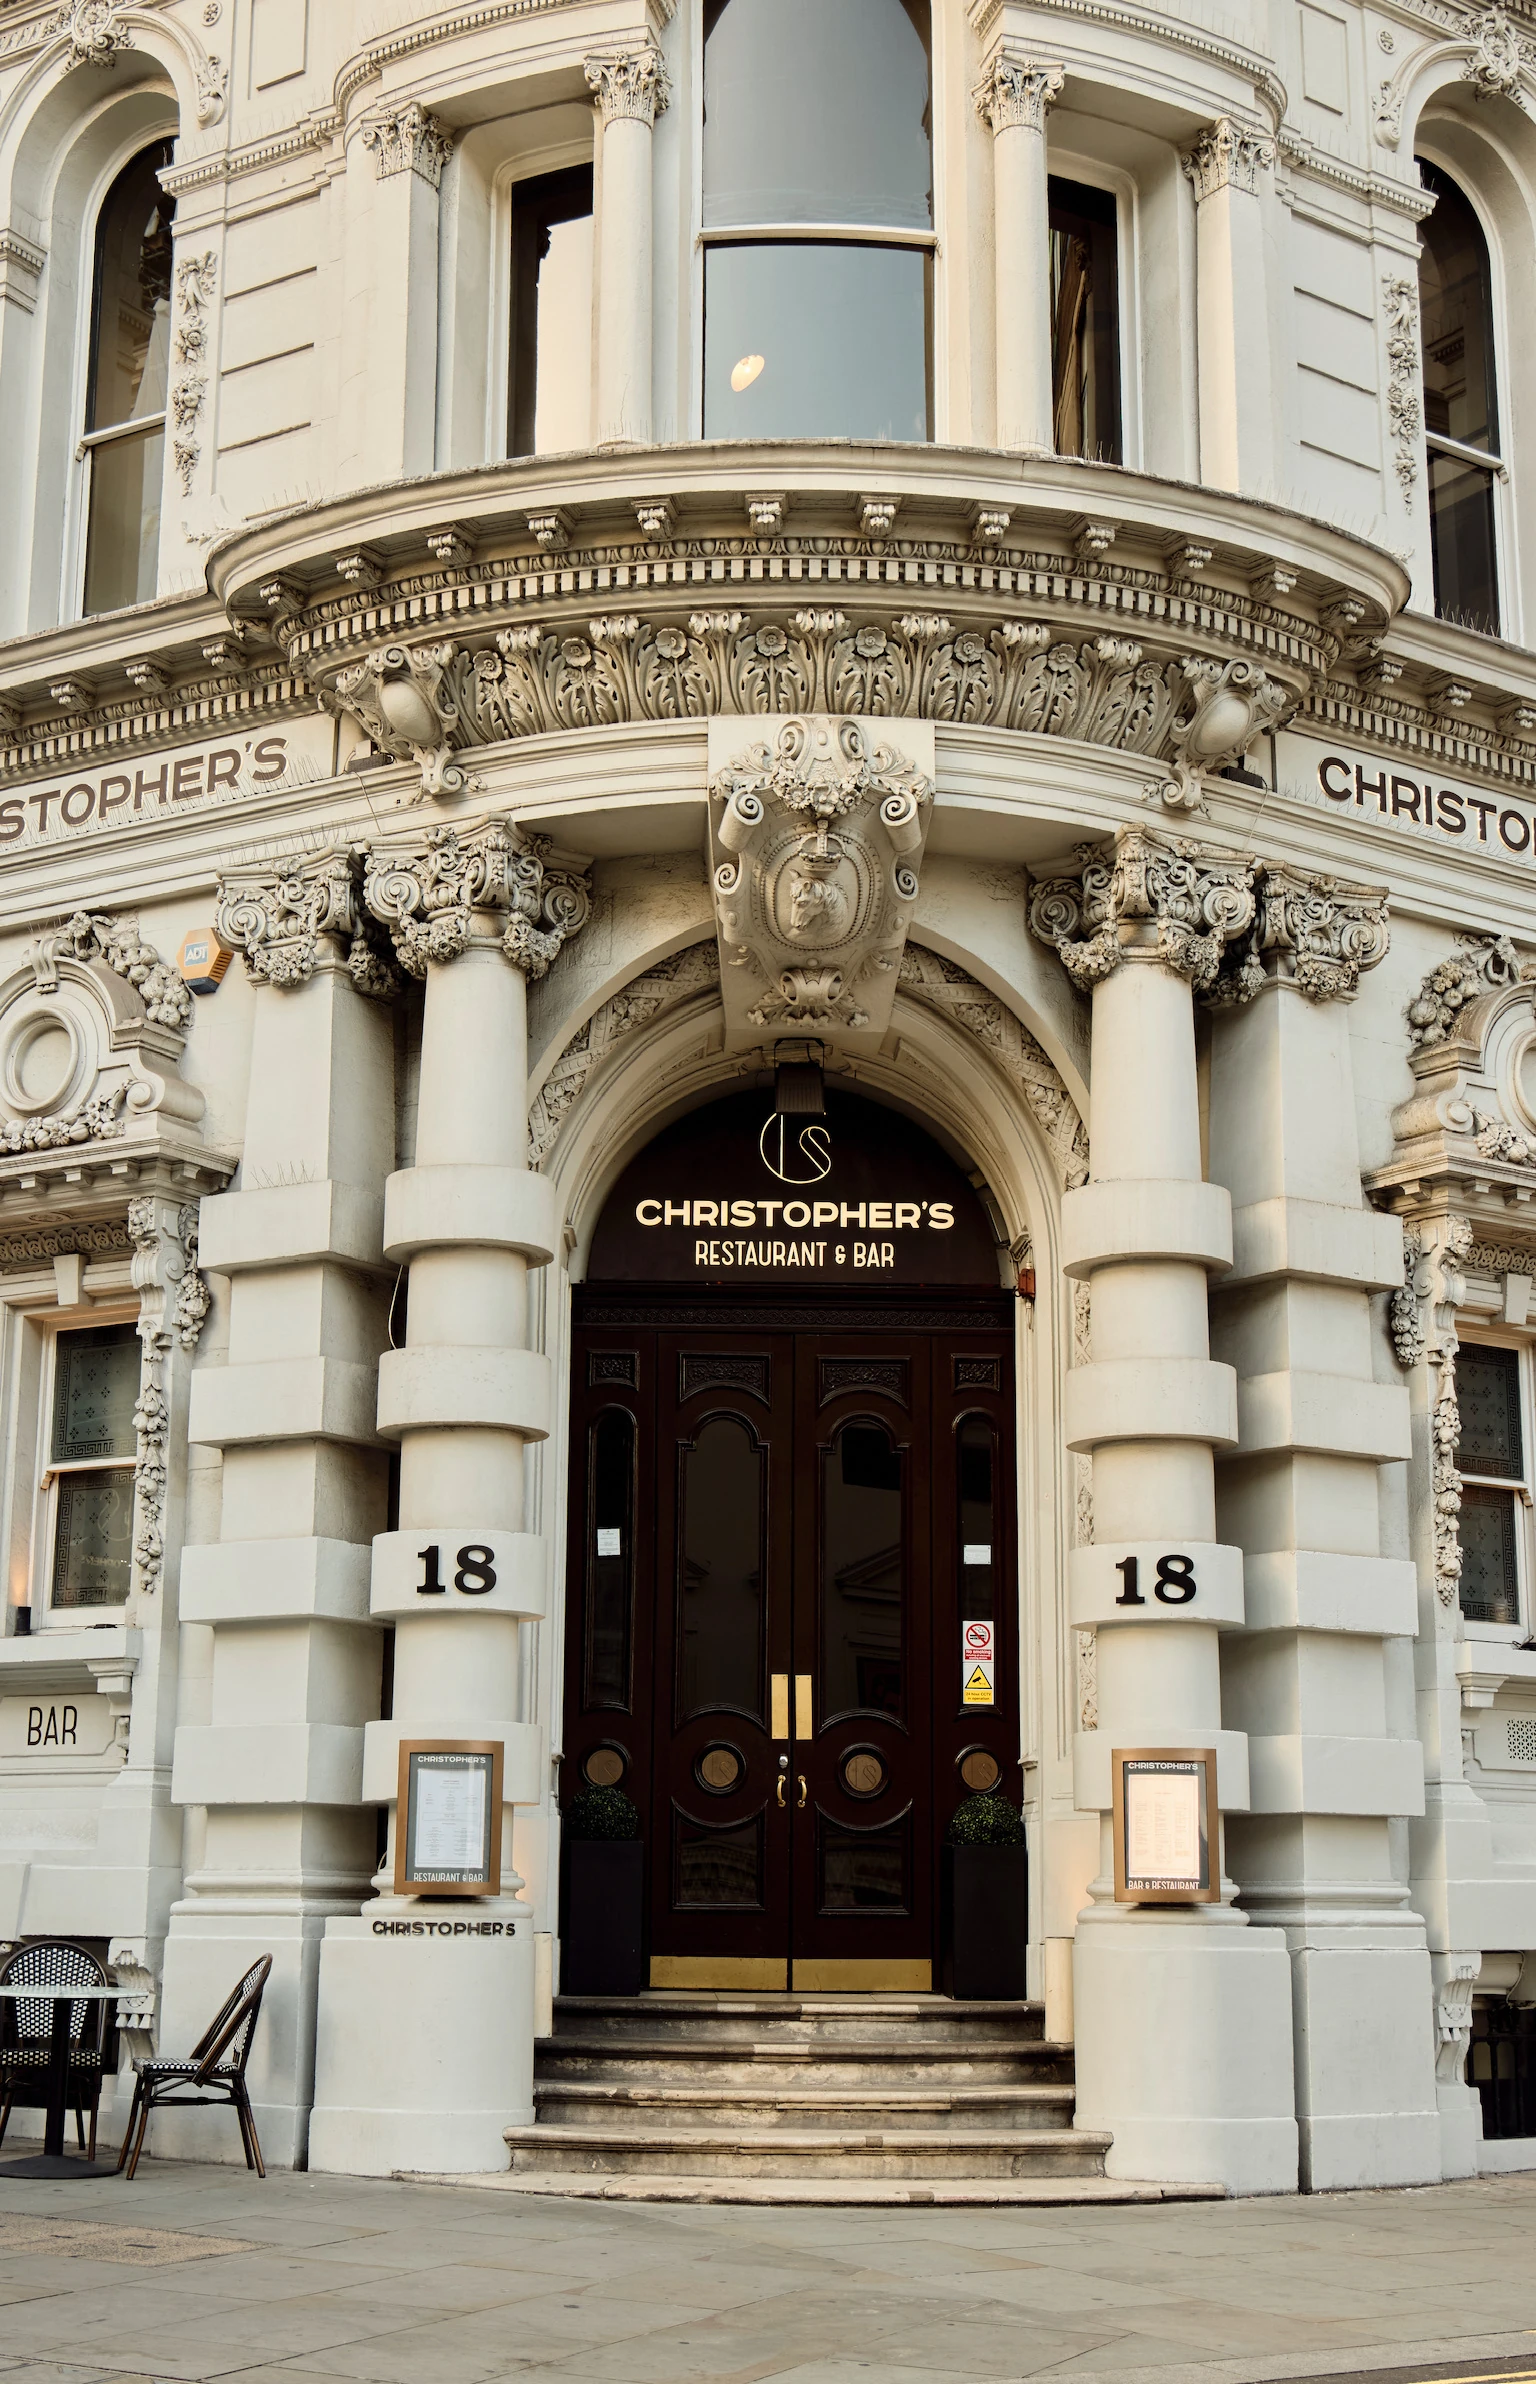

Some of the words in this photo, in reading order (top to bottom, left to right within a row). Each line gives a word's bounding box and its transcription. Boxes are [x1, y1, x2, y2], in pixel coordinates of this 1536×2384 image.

[0, 737, 289, 843] STOPHER'S
[1317, 756, 1536, 858] CHRISTO
[186, 945, 209, 962] ADT
[635, 1198, 956, 1230] CHRISTOPHER'S
[694, 1240, 828, 1268] RESTAURANT
[834, 1246, 846, 1264] &
[853, 1242, 895, 1268] BAR
[416, 1544, 497, 1595] 18
[1115, 1554, 1197, 1604] 18
[27, 1705, 78, 1746] BAR
[417, 1755, 487, 1764] CHRISTOPHER'S
[1127, 1762, 1199, 1771] CHRISTOPHER'S
[413, 1872, 461, 1882] RESTAURANT
[468, 1873, 484, 1882] BAR
[1128, 1880, 1144, 1890] BAR
[1151, 1880, 1200, 1890] RESTAURANT
